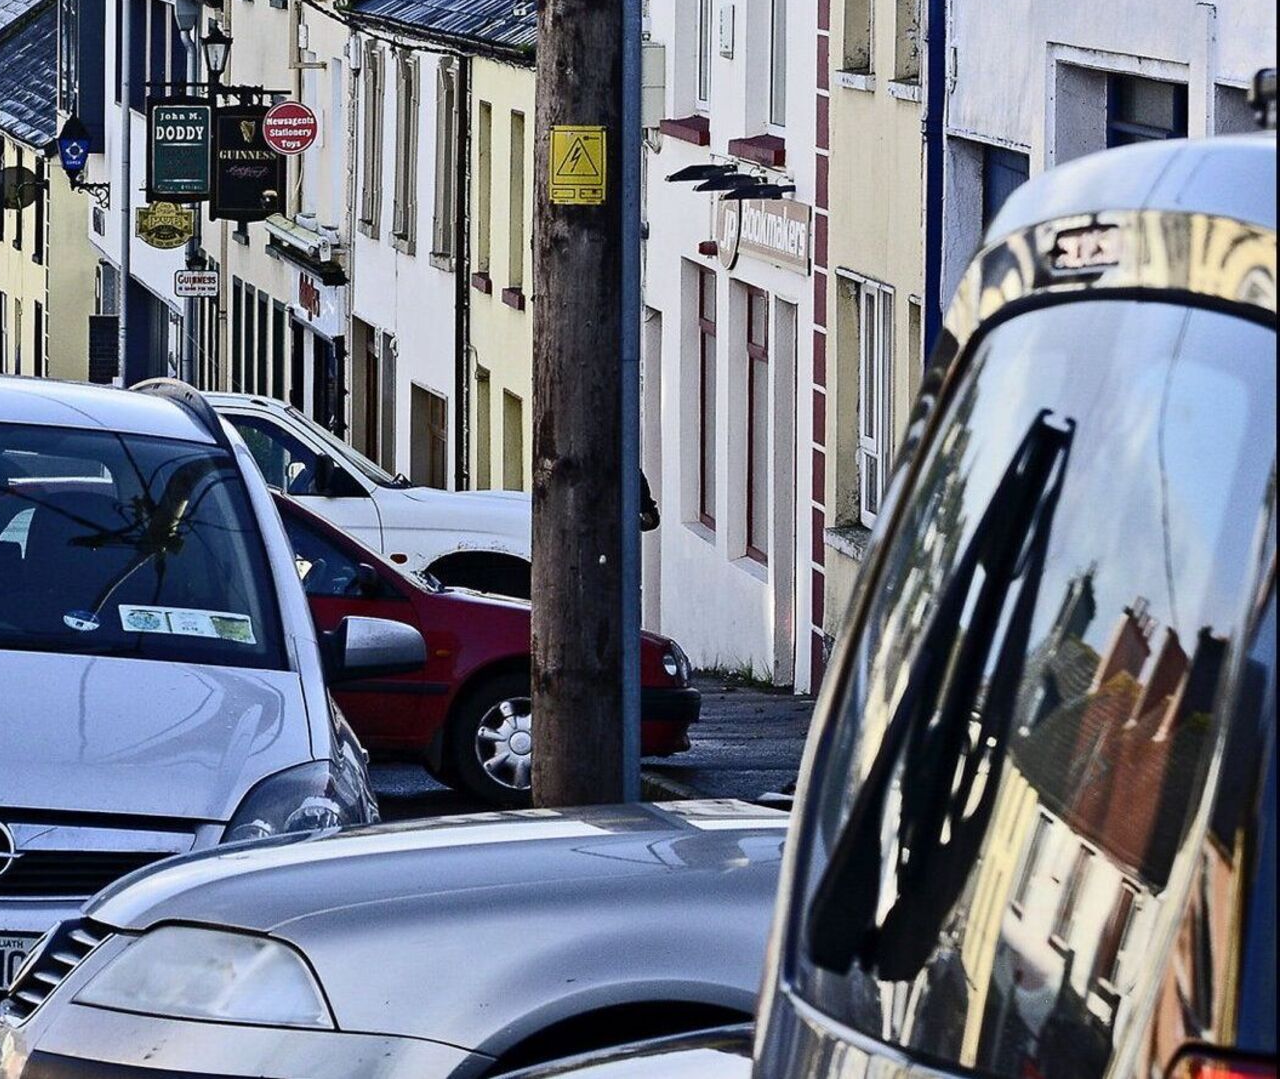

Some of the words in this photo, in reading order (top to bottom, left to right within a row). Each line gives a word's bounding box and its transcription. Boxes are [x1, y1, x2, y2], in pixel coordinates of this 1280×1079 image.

[160, 113, 185, 121] John
[189, 112, 202, 120] M.
[266, 117, 314, 126] Newsagents
[156, 126, 204, 140] DODDY
[270, 128, 312, 137] Stationery
[281, 140, 301, 148] Toys
[219, 150, 277, 160] GUINNESS
[741, 200, 806, 257] Bookmakers
